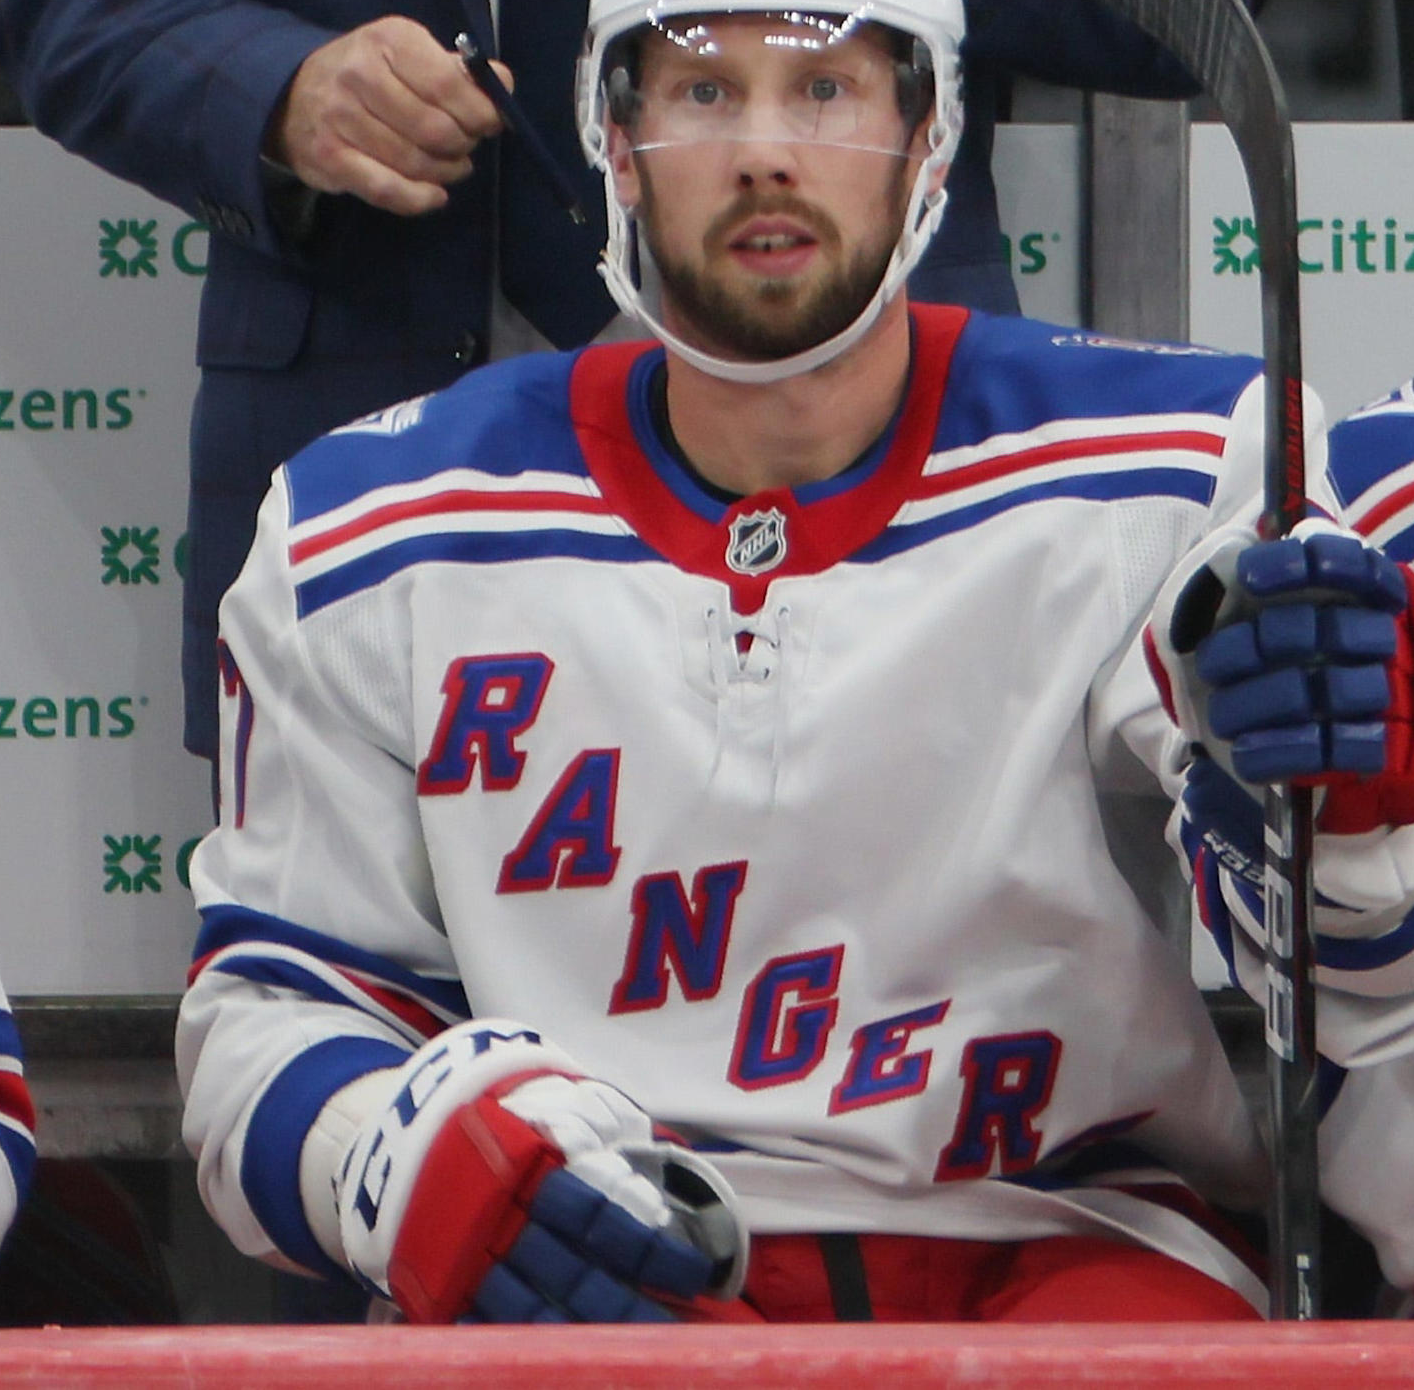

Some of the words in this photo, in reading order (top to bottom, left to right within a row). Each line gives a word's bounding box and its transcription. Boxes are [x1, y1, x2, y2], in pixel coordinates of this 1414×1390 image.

[217, 638, 254, 829] 7
[415, 652, 1063, 1183] RANGER
[353, 1029, 542, 1233] CCM
